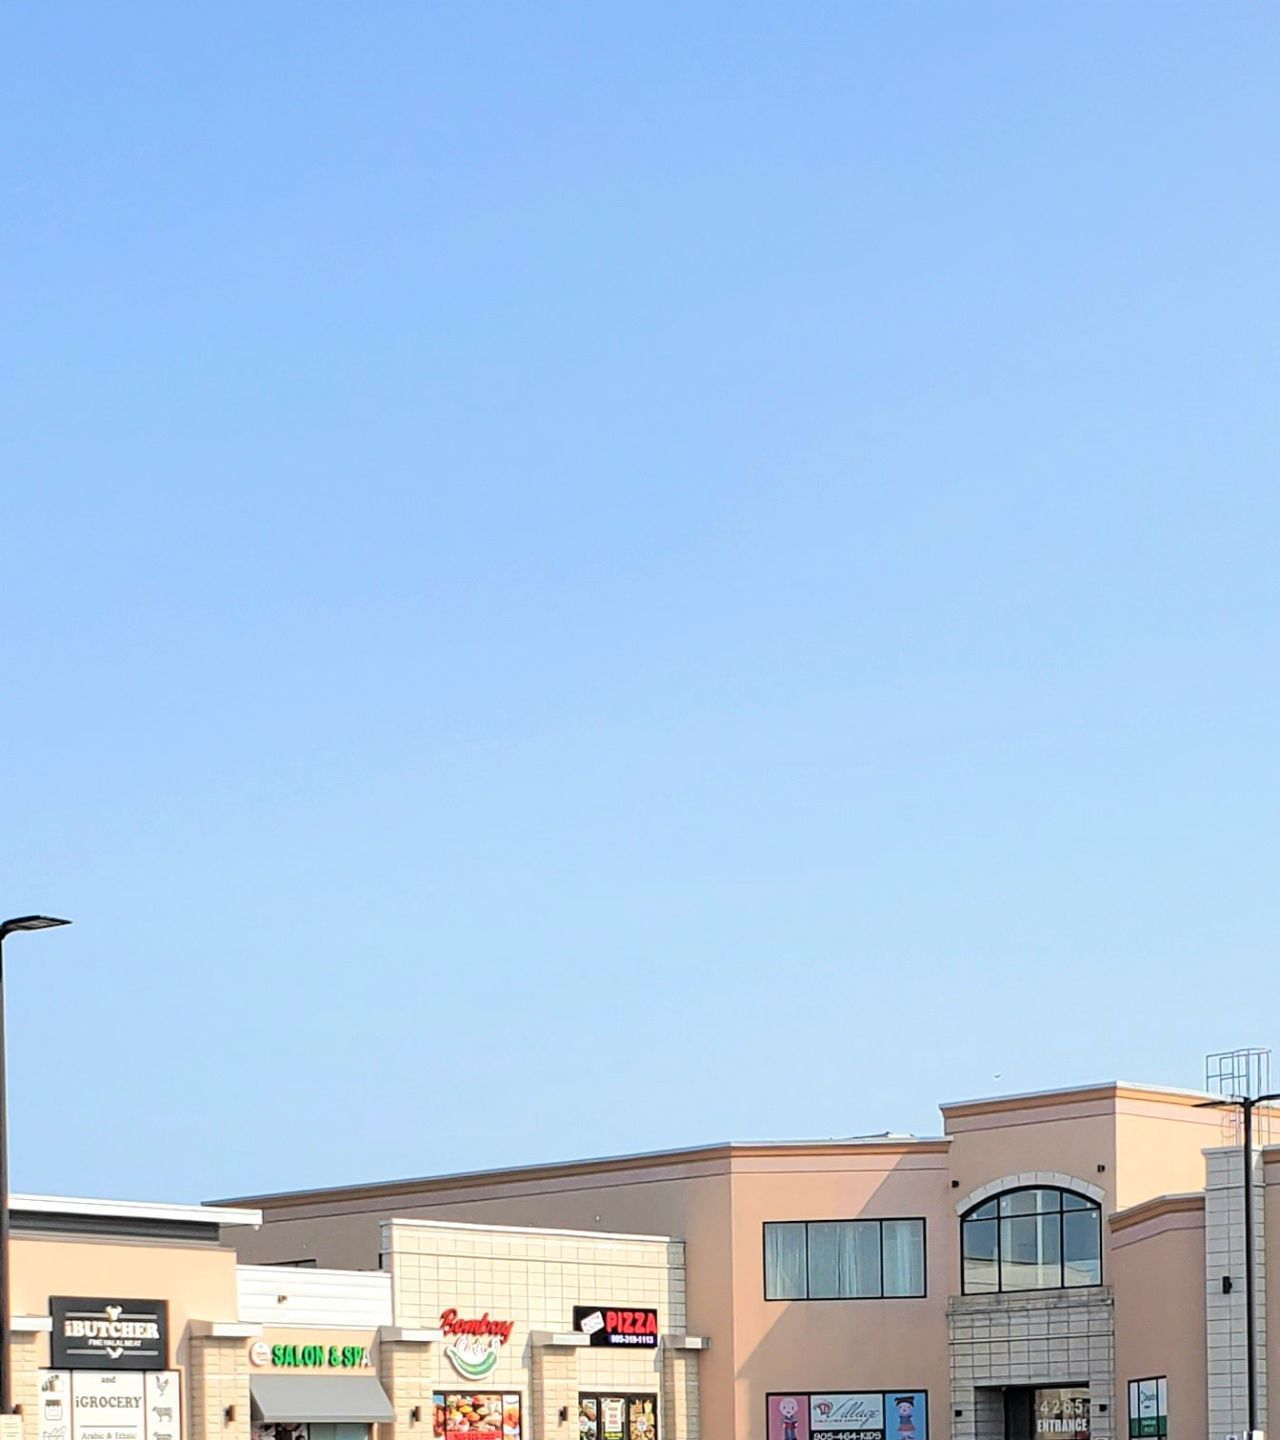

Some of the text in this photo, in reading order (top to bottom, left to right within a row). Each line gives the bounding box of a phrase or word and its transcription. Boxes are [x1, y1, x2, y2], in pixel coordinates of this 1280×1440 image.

[63, 1320, 160, 1339] iBUTCHER
[440, 1308, 515, 1346] Bombay
[605, 1311, 658, 1334] PIZZA
[271, 1344, 325, 1367] SALON
[328, 1345, 341, 1367] &
[341, 1346, 372, 1368] SPA
[100, 1376, 117, 1384] and
[75, 1396, 142, 1408] iGROCERY
[1039, 1399, 1084, 1415] 4265
[1037, 1418, 1088, 1433] ENTRANCE
[813, 1431, 882, 1440] 905-464-KIDS
